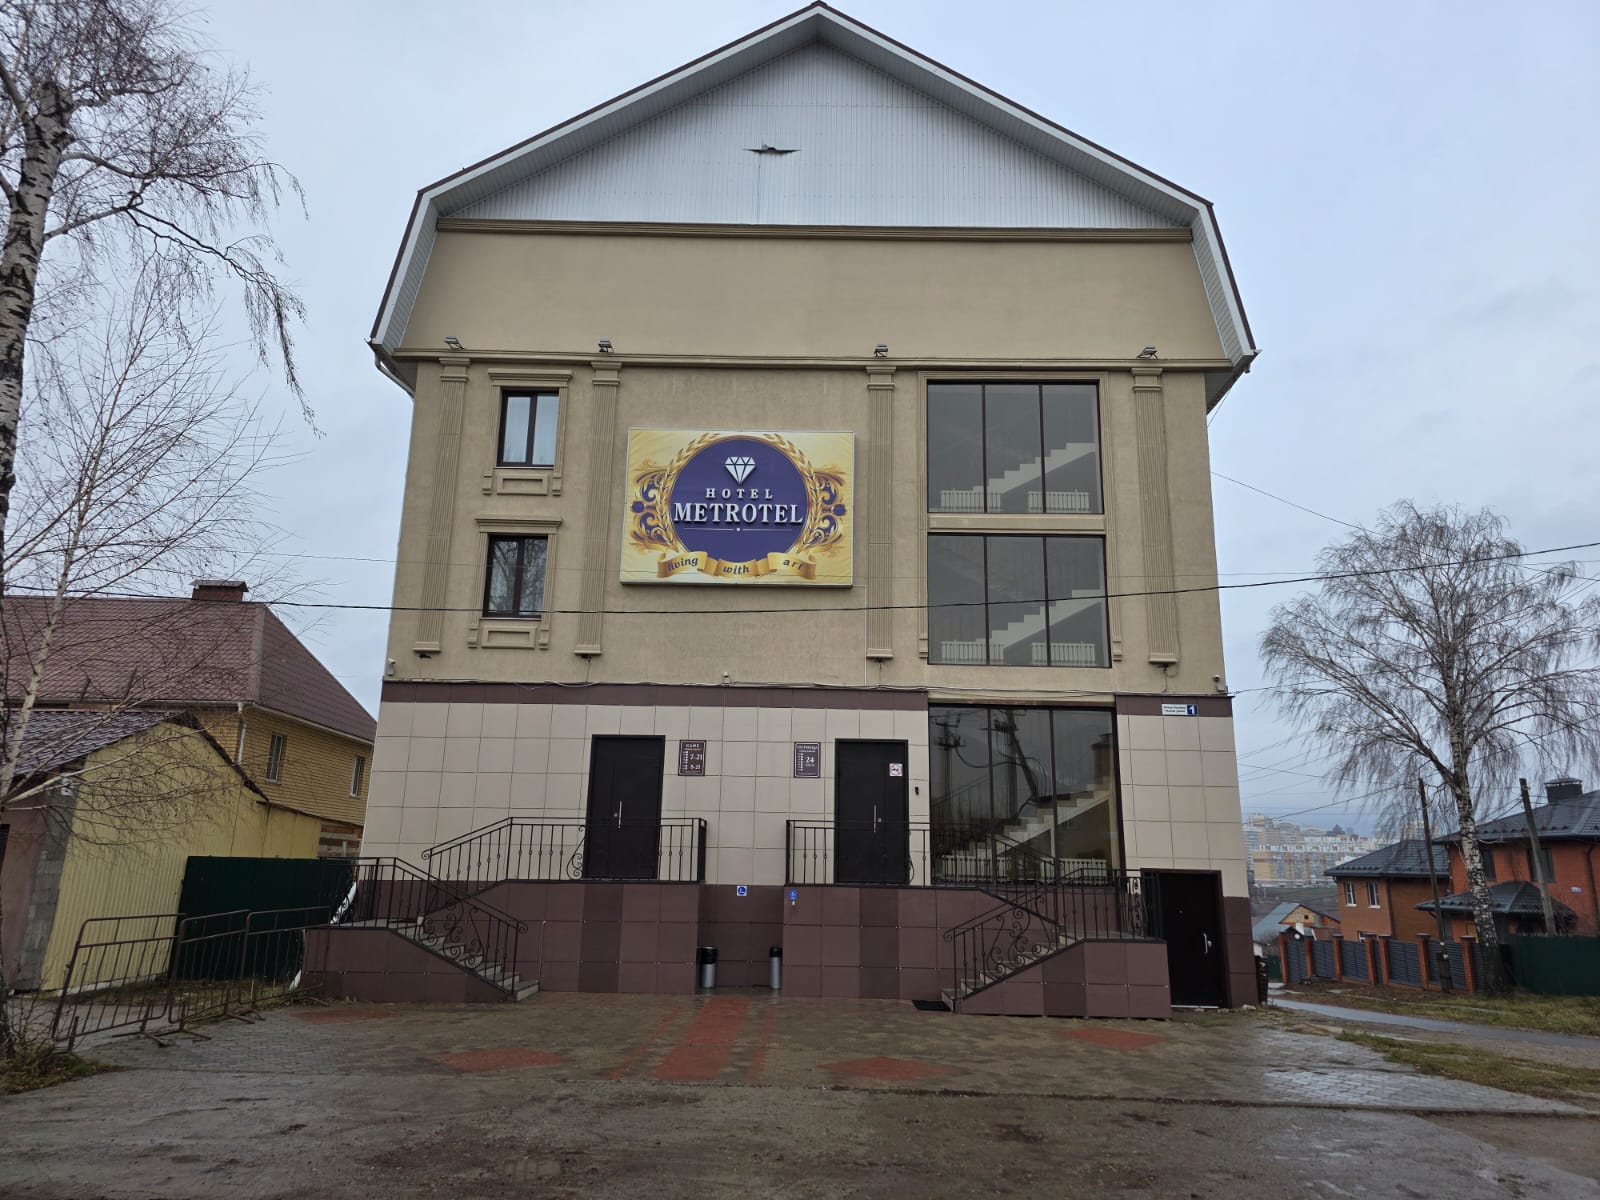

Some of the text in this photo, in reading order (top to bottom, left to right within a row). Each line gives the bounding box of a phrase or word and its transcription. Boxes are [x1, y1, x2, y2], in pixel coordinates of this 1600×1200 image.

[705, 488, 773, 499] HOTEL
[673, 502, 803, 524] METROTEL
[667, 557, 804, 574] living with art
